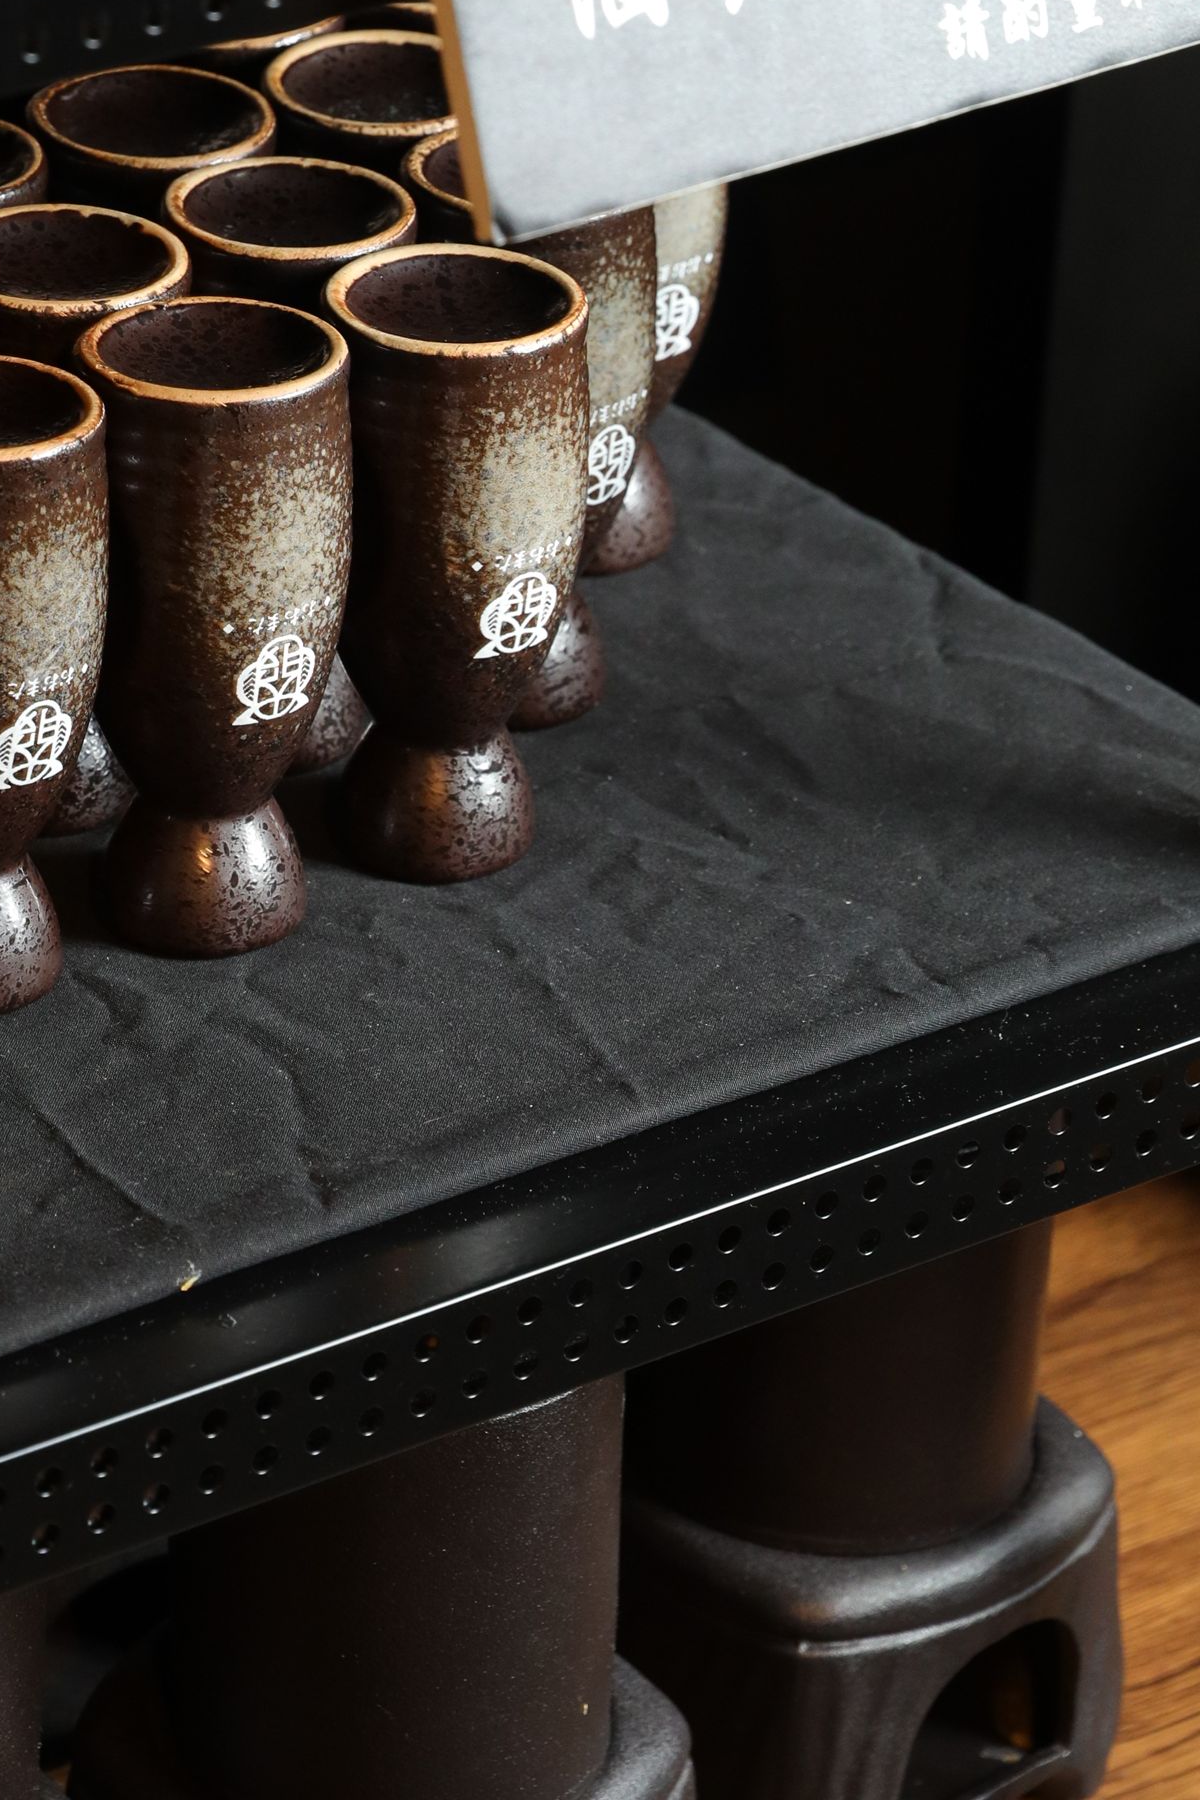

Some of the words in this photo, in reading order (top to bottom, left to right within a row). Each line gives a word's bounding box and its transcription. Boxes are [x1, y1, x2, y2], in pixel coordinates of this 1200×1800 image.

[493, 539, 560, 573] おおまた
[247, 600, 317, 636] おおまた
[7, 666, 75, 701] おおまた
